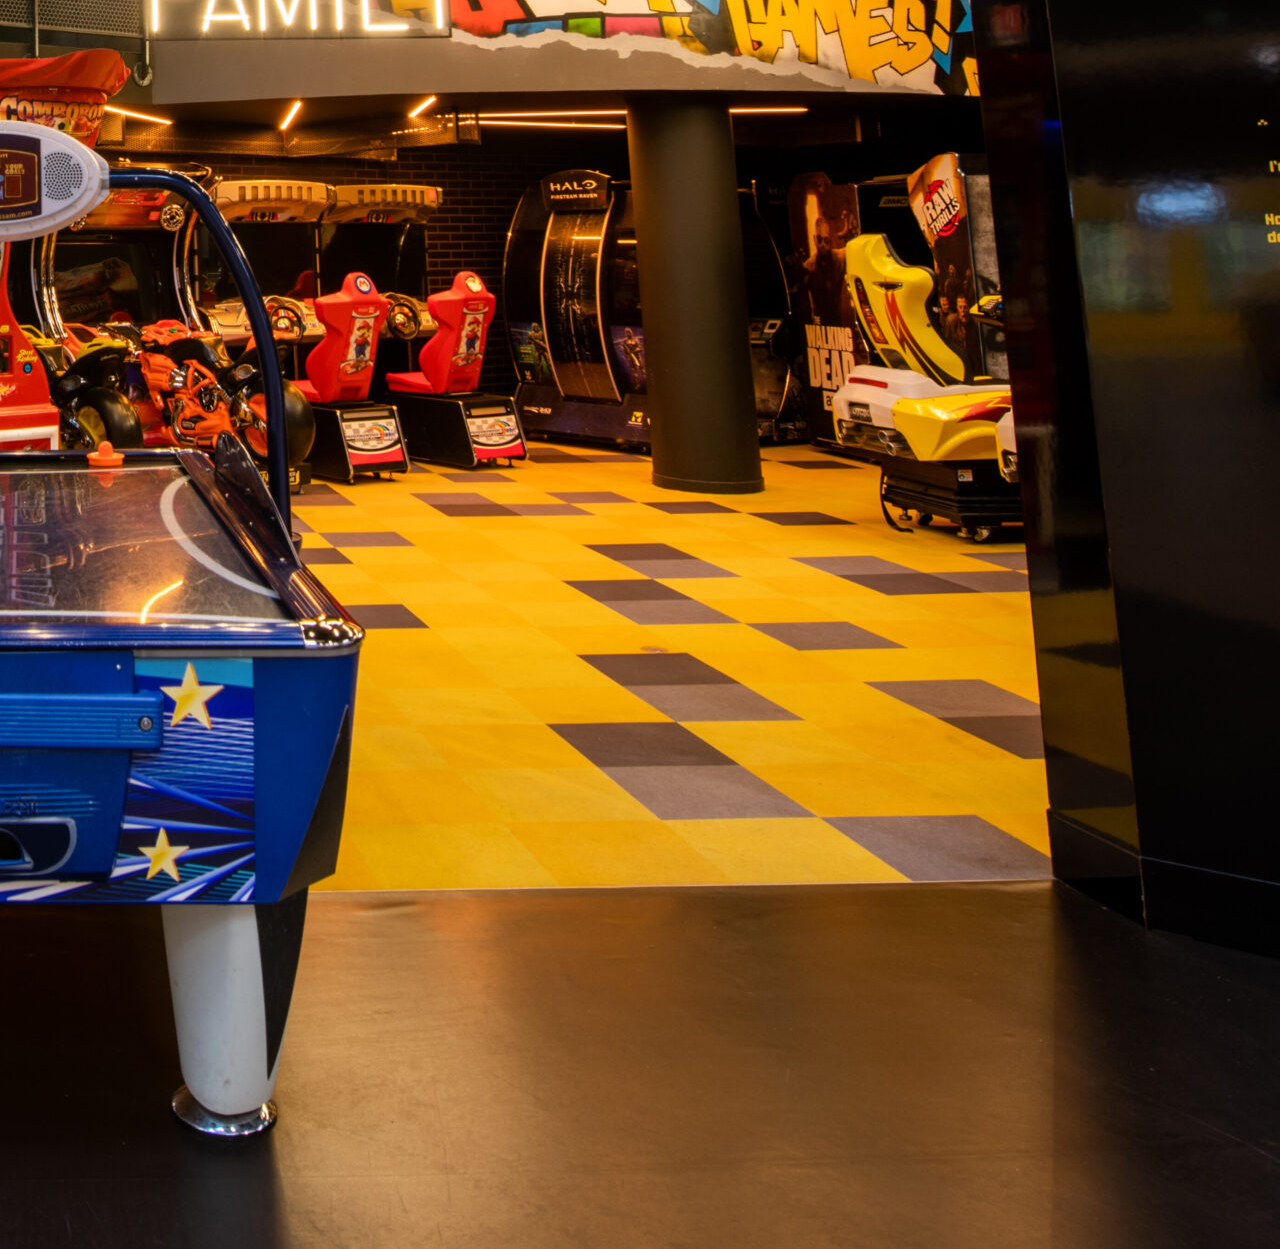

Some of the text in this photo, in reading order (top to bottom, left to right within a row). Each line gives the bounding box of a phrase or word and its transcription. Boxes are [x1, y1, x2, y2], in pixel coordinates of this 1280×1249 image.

[550, 180, 598, 191] HALO
[922, 178, 955, 226] RAW
[929, 198, 960, 236] THRILLS
[805, 324, 854, 351] WALKING
[807, 347, 856, 390] DEAD
